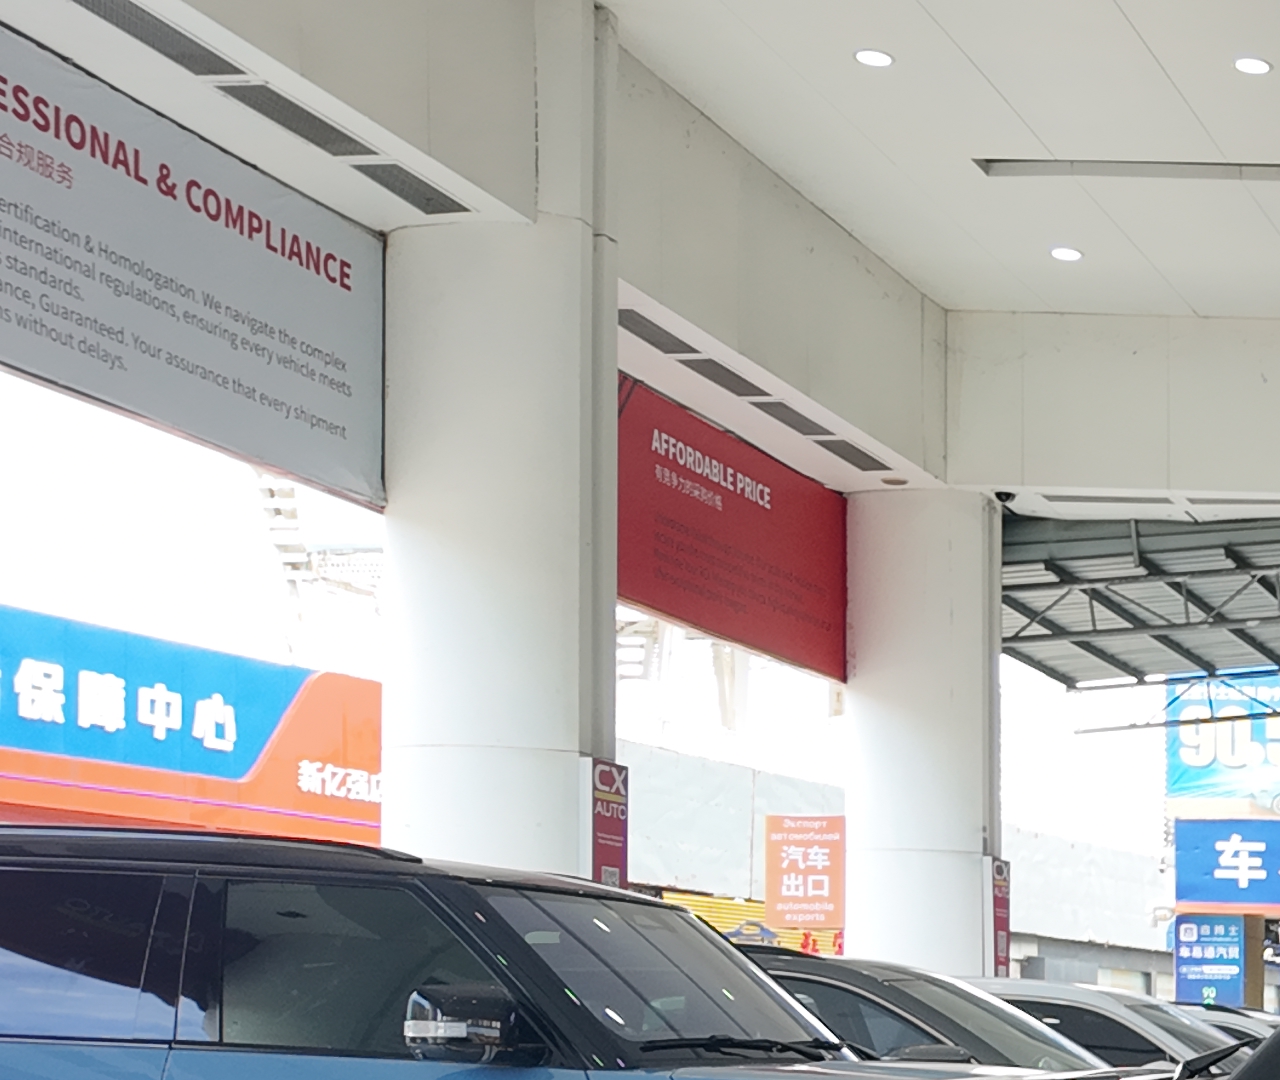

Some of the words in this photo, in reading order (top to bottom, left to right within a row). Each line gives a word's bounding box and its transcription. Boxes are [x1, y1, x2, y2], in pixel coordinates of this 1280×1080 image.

[156, 162, 178, 201] &
[185, 179, 352, 292] COMPLIANCE
[5, 254, 85, 302] standards.
[83, 234, 95, 255] &
[98, 241, 199, 304] Homologation.
[202, 290, 222, 315] We
[225, 305, 276, 340] navigate
[279, 328, 297, 350] the
[300, 340, 347, 373] complex
[15, 313, 75, 351] without
[78, 336, 128, 372] delays.
[39, 293, 129, 347] Guaranteed.
[131, 332, 163, 360] Your
[165, 350, 230, 390] assurance
[232, 377, 258, 403] that
[259, 392, 292, 419] every
[294, 405, 347, 440] shipment
[99, 271, 180, 322] regulations,
[183, 310, 238, 350] ensuring
[241, 336, 274, 365] every
[276, 352, 316, 382] vehicle
[319, 371, 353, 398] meets
[651, 429, 734, 491] AFFORDABLE
[736, 472, 771, 510] PRICE
[13, 657, 238, 753] 保障中心
[594, 763, 626, 796] CX
[594, 801, 627, 820] AUTO
[780, 845, 830, 870] 汽车
[781, 872, 830, 898] 出口
